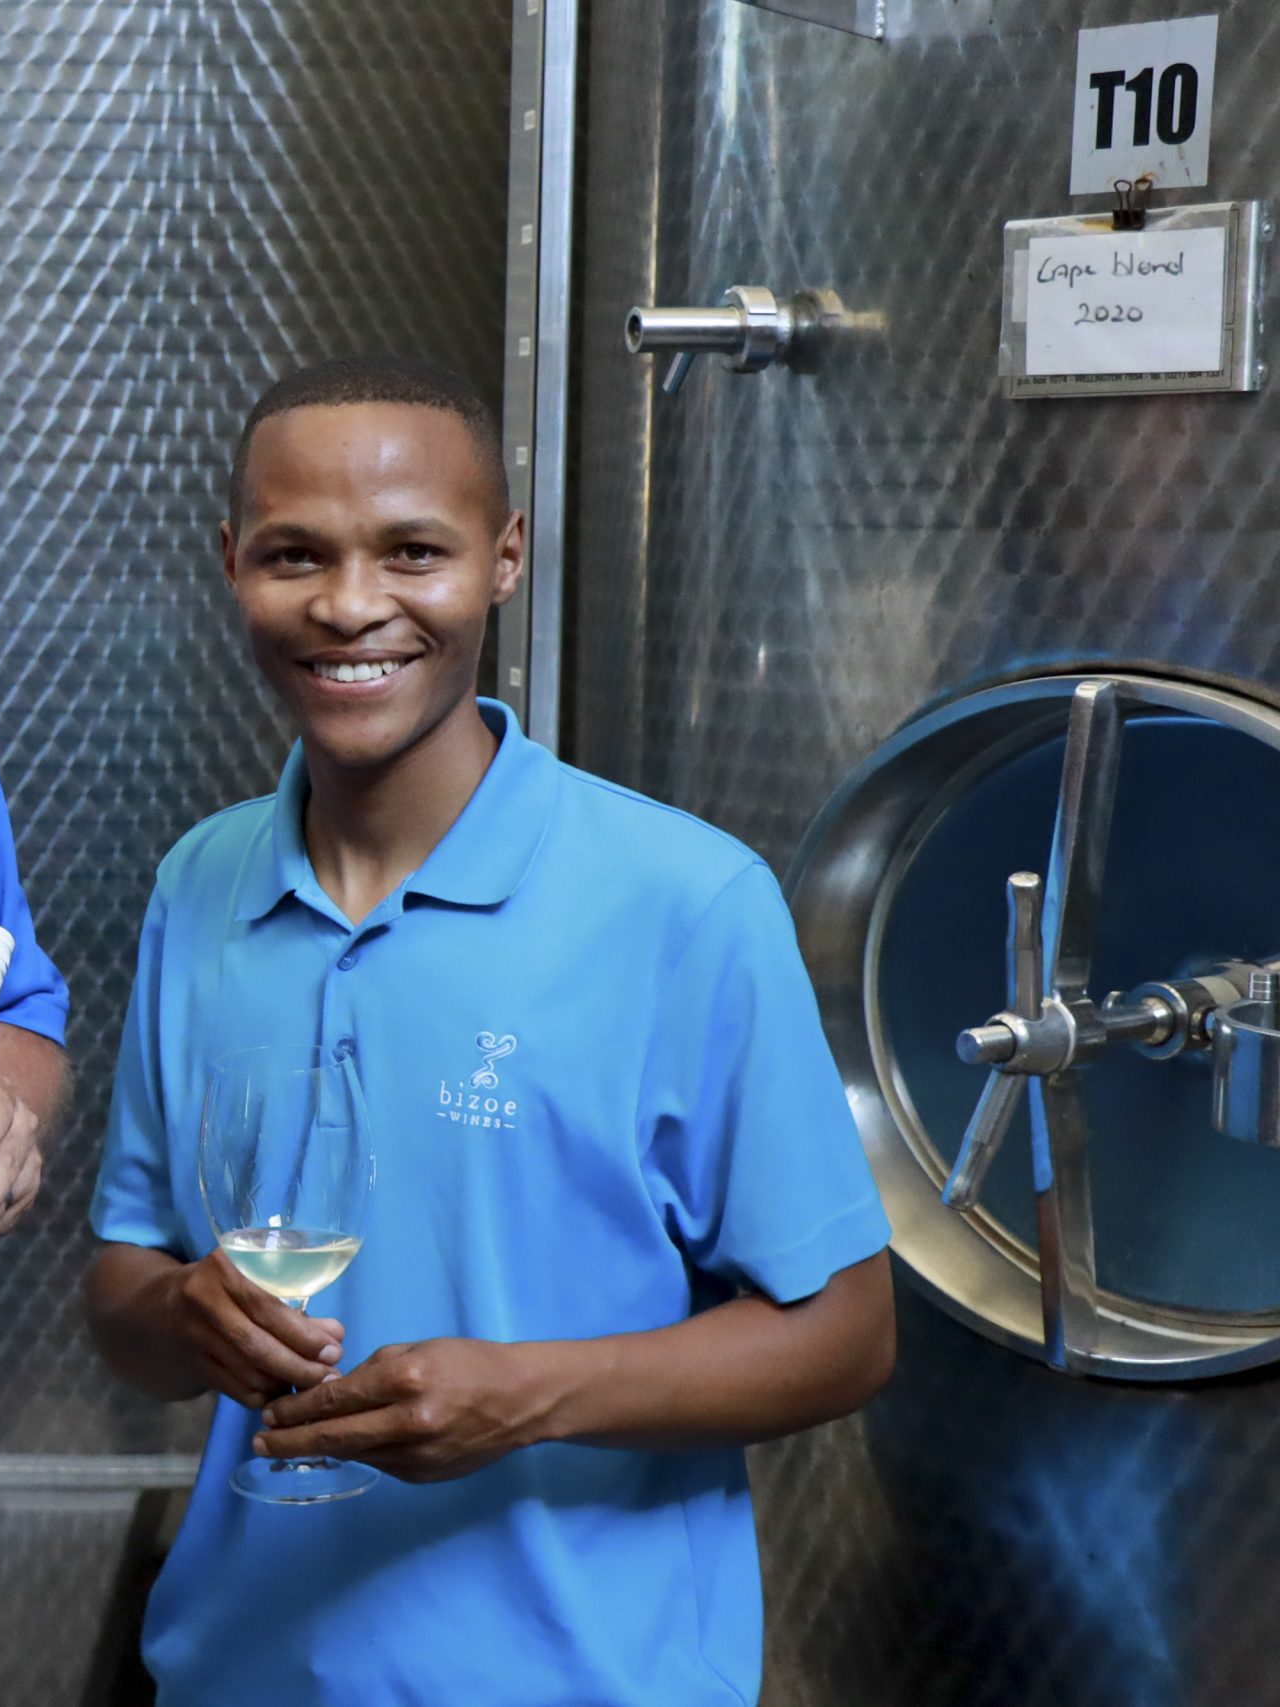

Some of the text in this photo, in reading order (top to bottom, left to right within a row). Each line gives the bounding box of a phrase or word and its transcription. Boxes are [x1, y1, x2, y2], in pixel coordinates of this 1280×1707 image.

[1089, 62, 1198, 150] T10
[1037, 256, 1097, 288] Cape
[1074, 302, 1144, 326] 2020
[439, 1080, 517, 1116] bizoe
